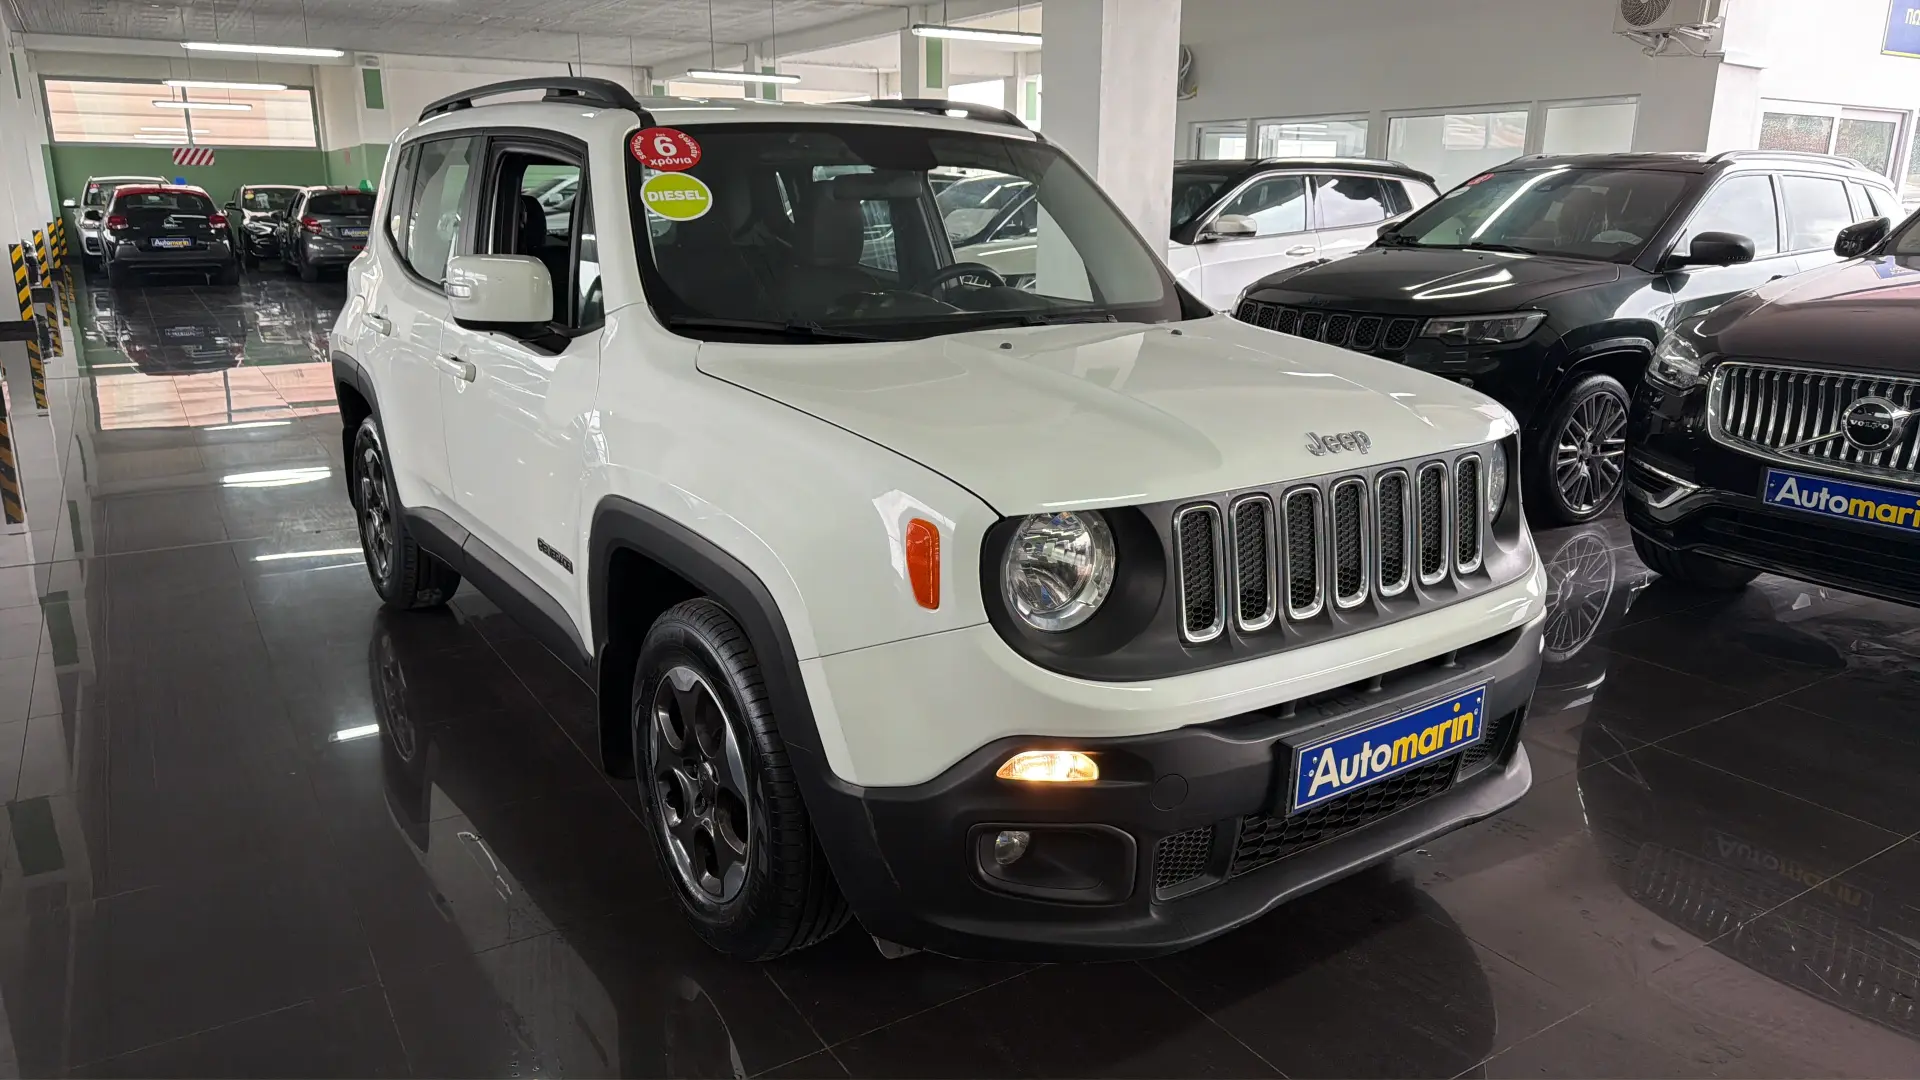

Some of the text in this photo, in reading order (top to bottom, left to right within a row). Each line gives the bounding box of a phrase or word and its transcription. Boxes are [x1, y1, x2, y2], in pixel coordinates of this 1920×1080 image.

[632, 135, 646, 160] service
[653, 136, 677, 157] 6
[650, 157, 692, 167] χρόνια
[647, 190, 706, 202] DIESEL
[1850, 420, 1890, 430] VOLVO
[1305, 431, 1372, 456] Jeep
[1308, 702, 1474, 798] Automarin
